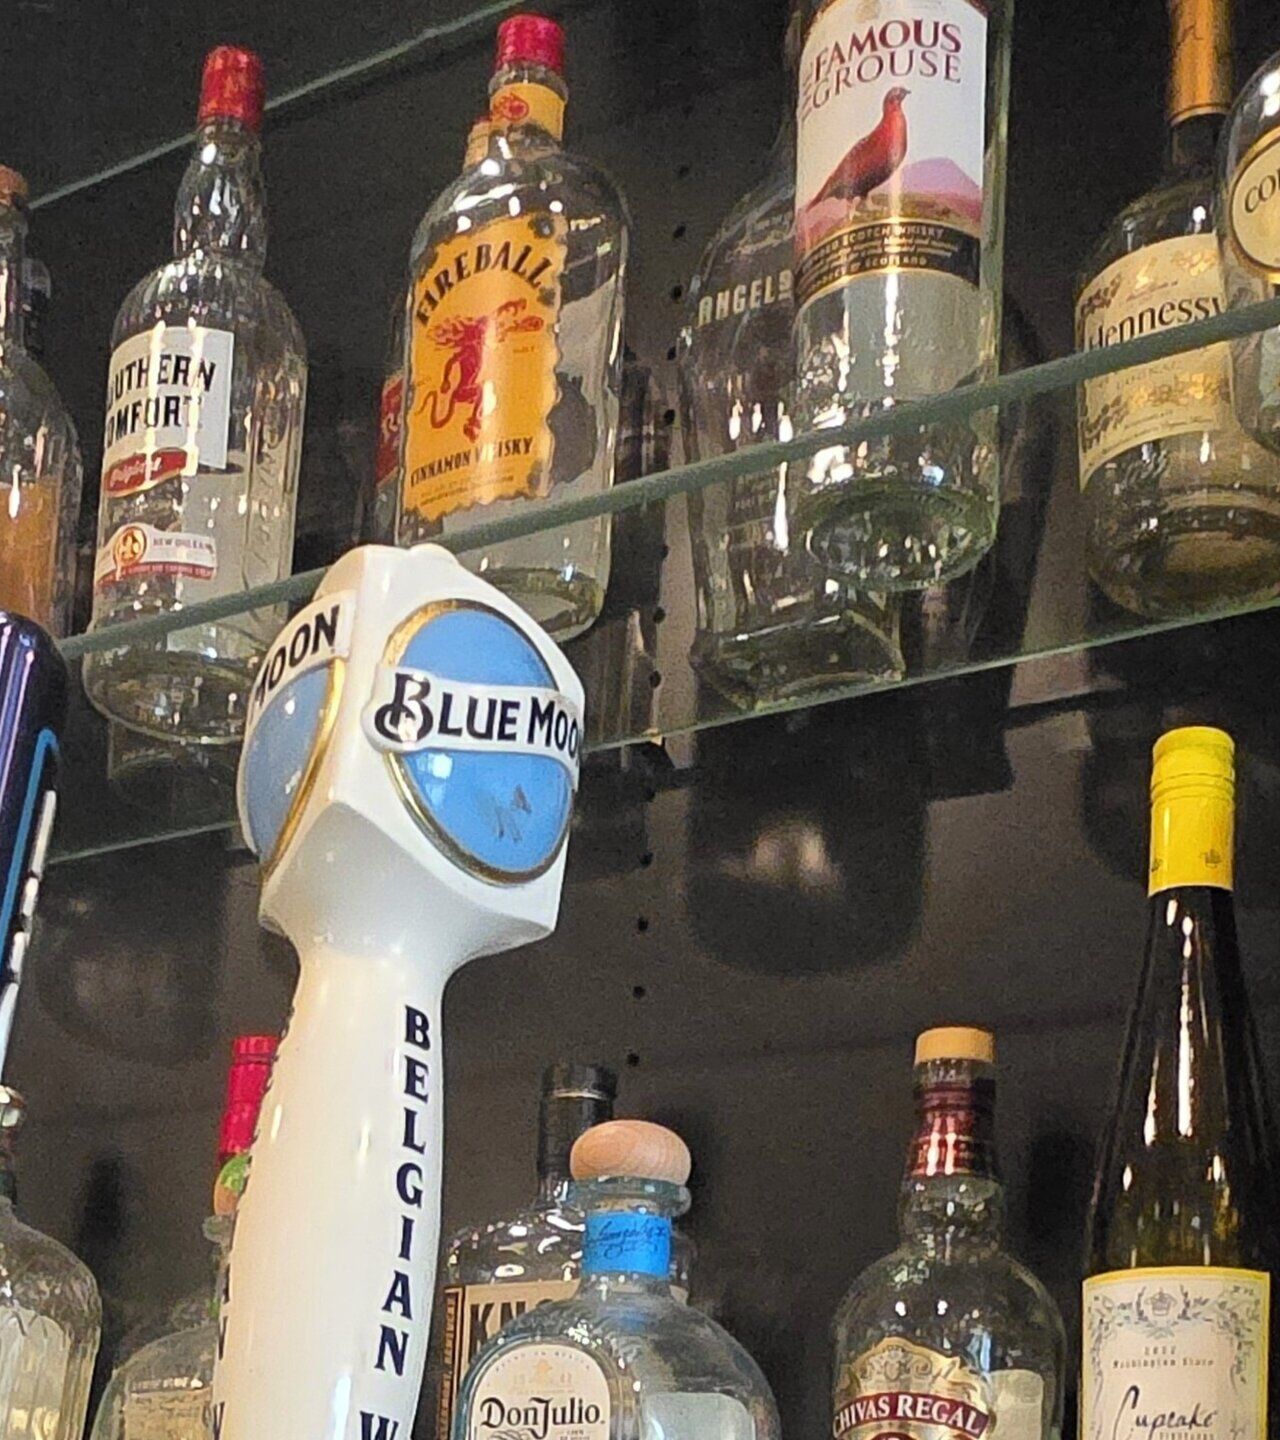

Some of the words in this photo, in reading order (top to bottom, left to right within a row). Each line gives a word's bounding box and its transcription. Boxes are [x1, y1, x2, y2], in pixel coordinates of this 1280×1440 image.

[812, 49, 961, 109] GROUSE
[813, 19, 962, 82] FAMOUS
[416, 241, 552, 326] FIREBALL
[410, 448, 472, 487] CINNAMON
[473, 436, 534, 463] ISKY
[374, 672, 519, 744] BLUE
[527, 696, 579, 760] MOO
[374, 1004, 431, 1377] BELGIAN
[480, 1396, 538, 1429] Don
[529, 1396, 601, 1440] Julio
[833, 1394, 891, 1438] CHIVAS
[895, 1394, 980, 1435] REGAL
